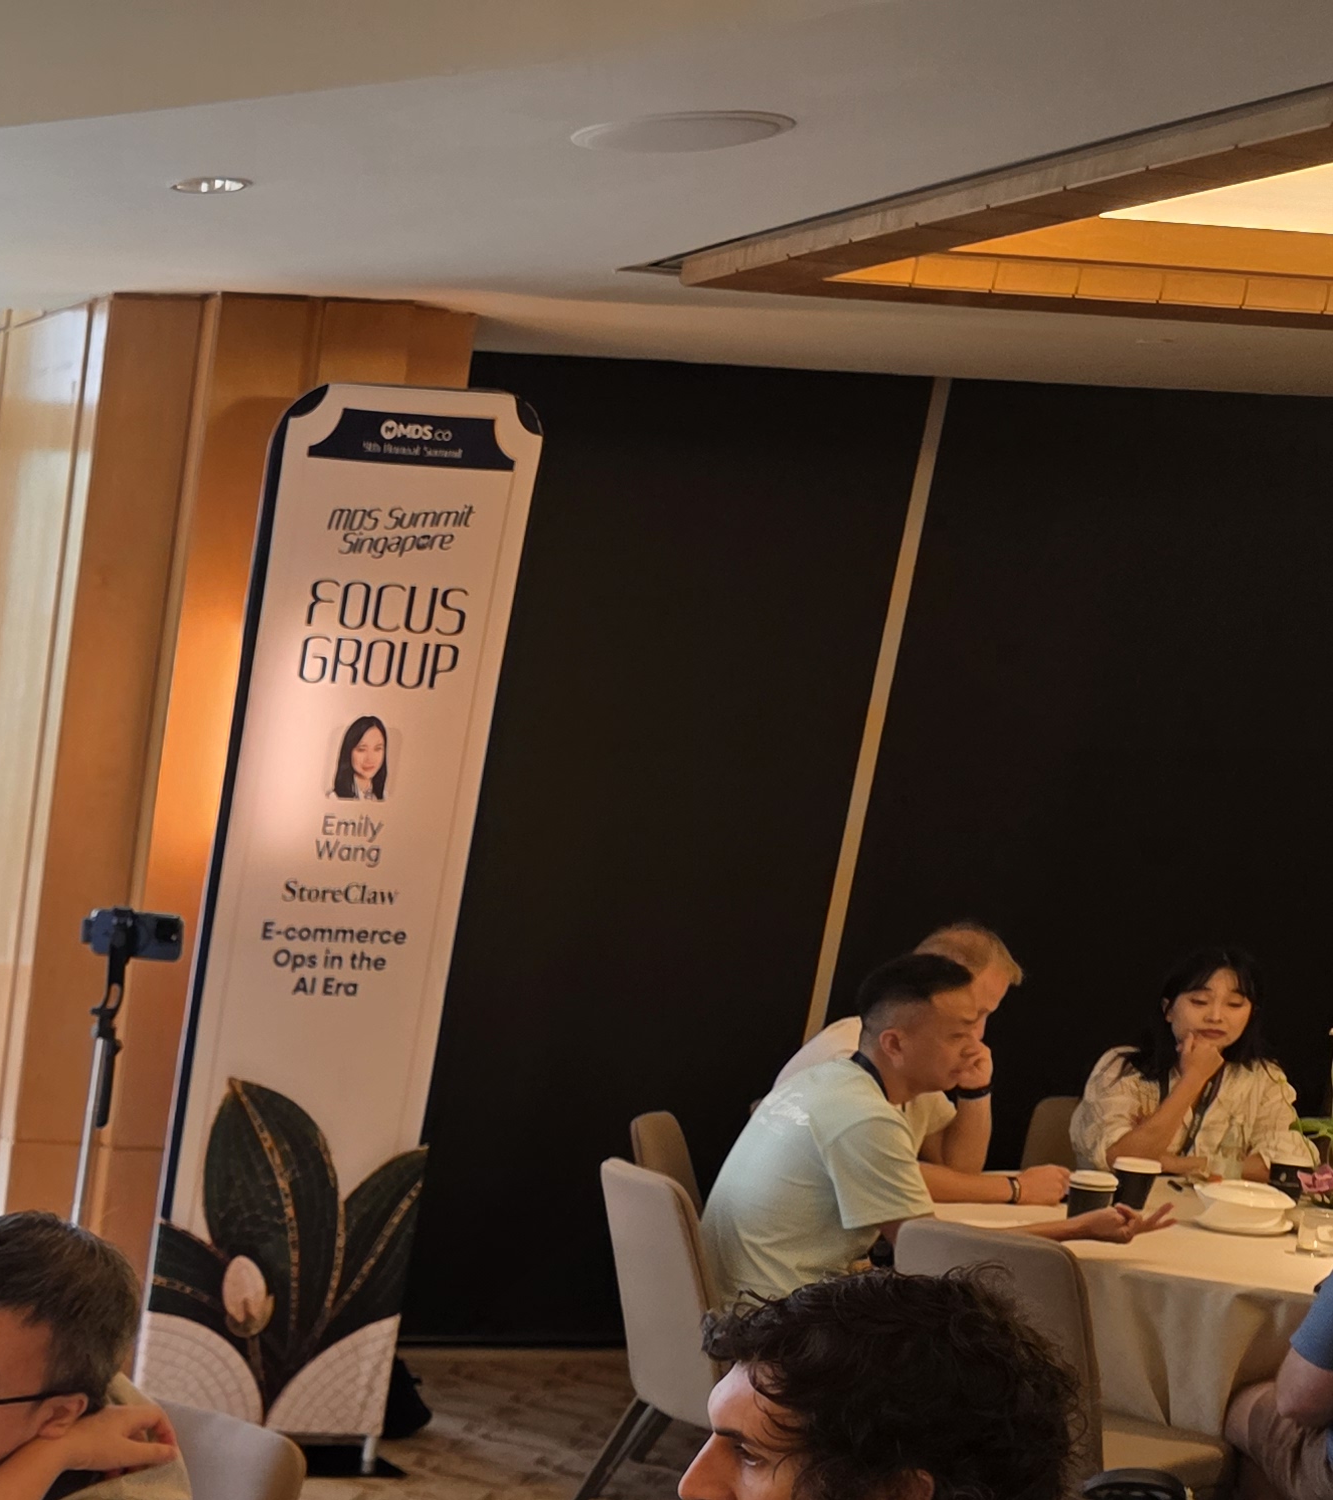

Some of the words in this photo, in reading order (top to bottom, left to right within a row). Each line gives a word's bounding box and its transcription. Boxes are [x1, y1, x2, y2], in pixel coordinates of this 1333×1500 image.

[326, 506, 382, 531] MDS
[384, 504, 476, 531] Summit
[337, 531, 455, 559] Singapore
[306, 577, 469, 637] FOCUS
[297, 635, 460, 690] GROUP
[321, 814, 384, 843] Emily
[315, 838, 381, 868] Wang
[282, 878, 399, 905] StoreClaw
[261, 920, 407, 945] E-commerce
[273, 949, 317, 973] Ops
[324, 948, 343, 971] in
[350, 950, 387, 971] the
[292, 977, 317, 996] AI
[322, 977, 358, 997] Era
